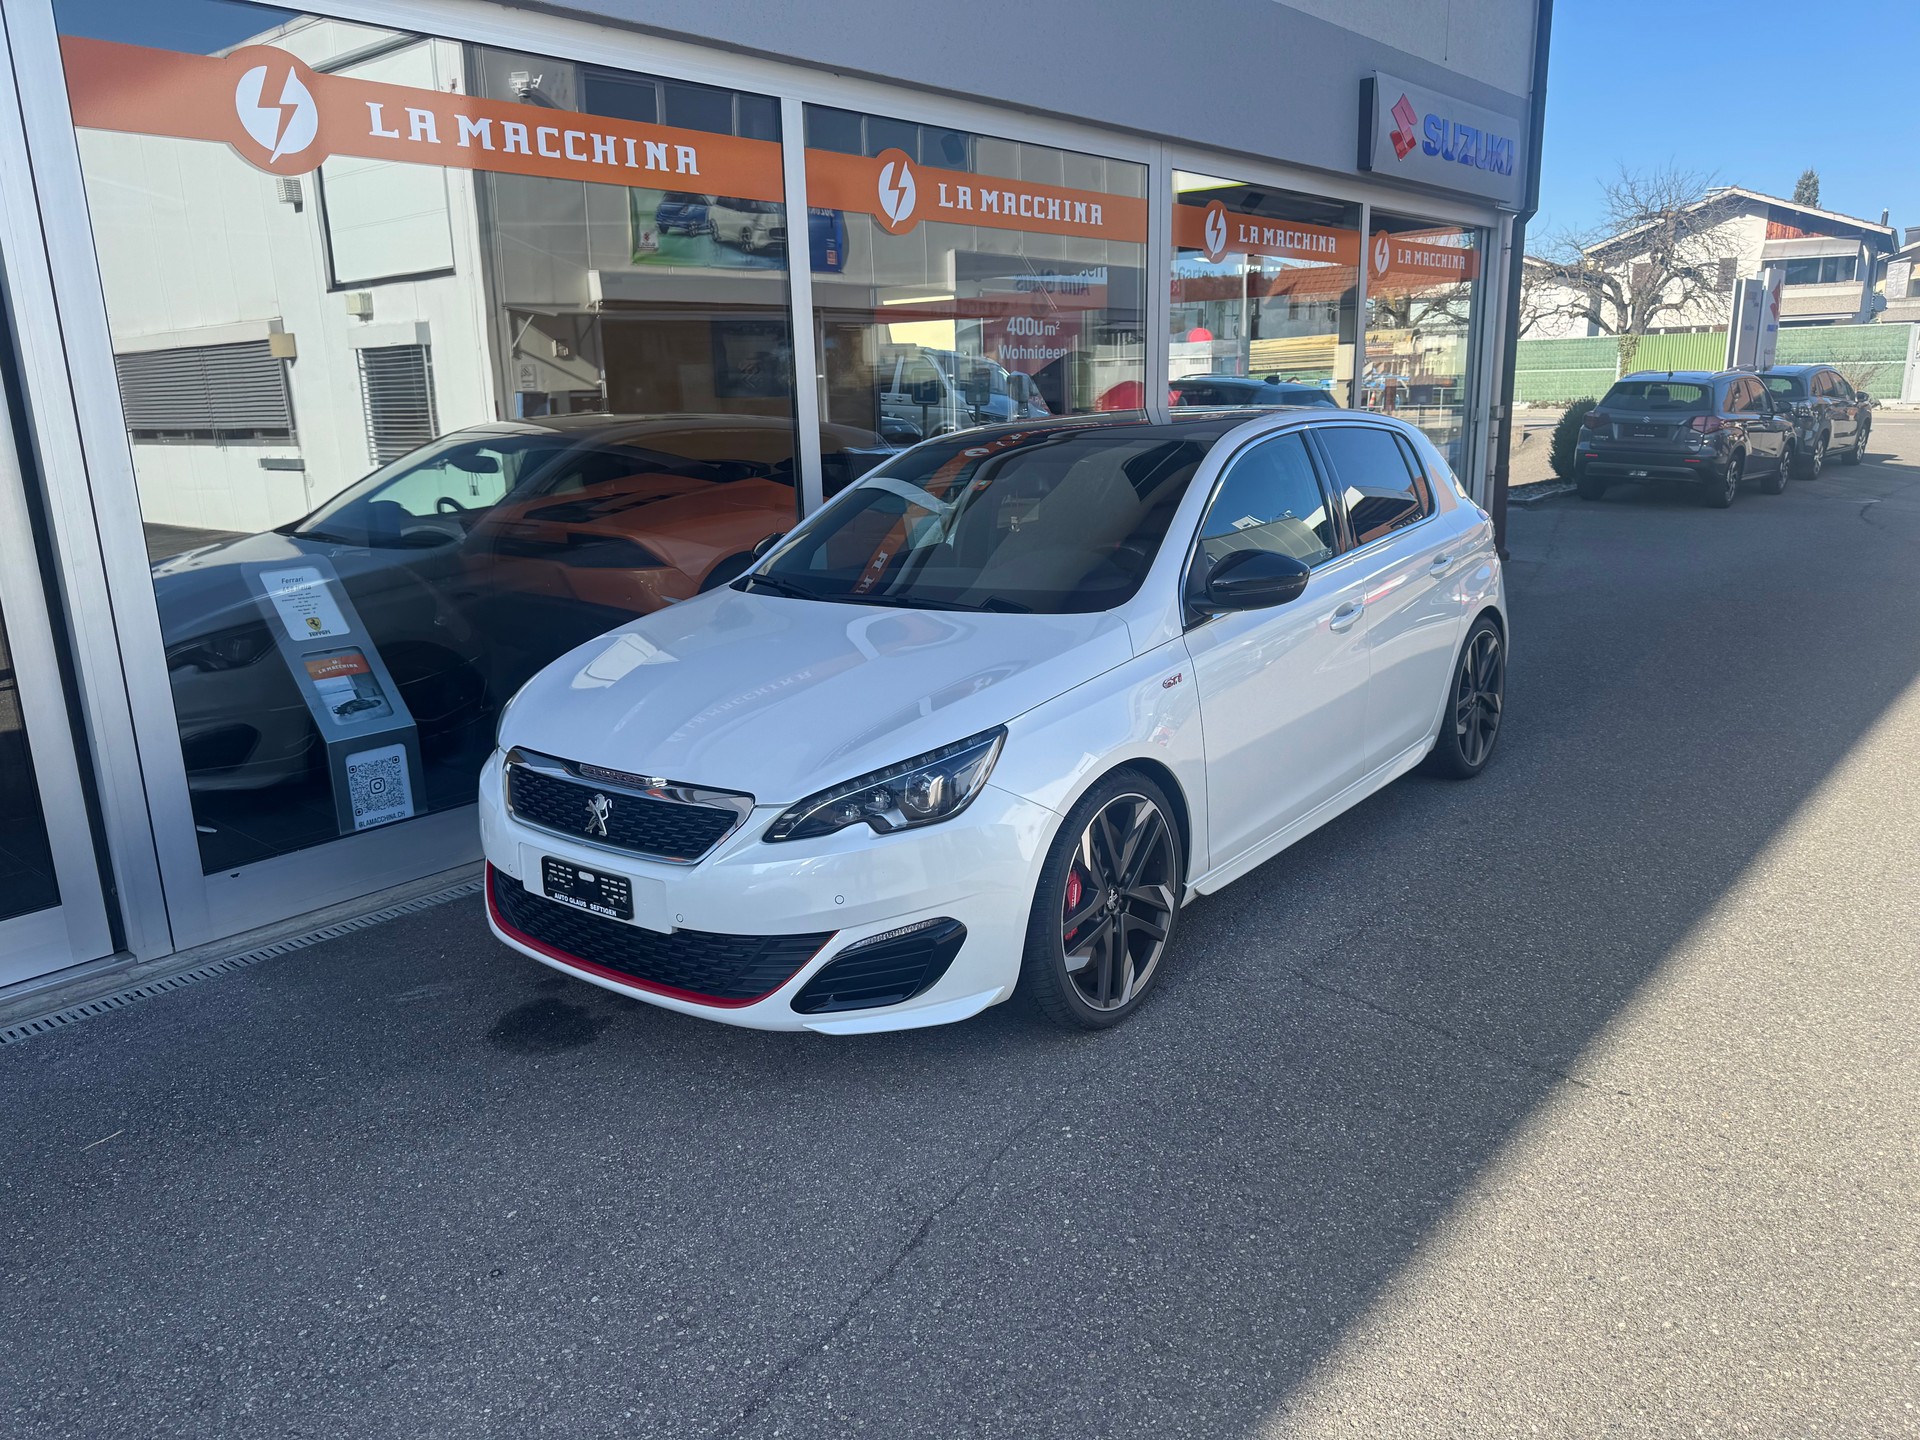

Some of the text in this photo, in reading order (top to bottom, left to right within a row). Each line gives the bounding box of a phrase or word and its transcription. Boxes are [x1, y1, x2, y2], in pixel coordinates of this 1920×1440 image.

[365, 101, 700, 176] LA MACCHINA
[1422, 113, 1514, 177] SUZUKI
[938, 183, 1103, 225] LA MACCHINA
[1239, 224, 1336, 254] LA MACCHINA
[1397, 248, 1465, 270] LA MACCHINA
[999, 344, 1067, 360] Wohnideen
[281, 576, 304, 584] Ferrari
[554, 892, 617, 917] AUTO GLAUS SEFTIGEN
